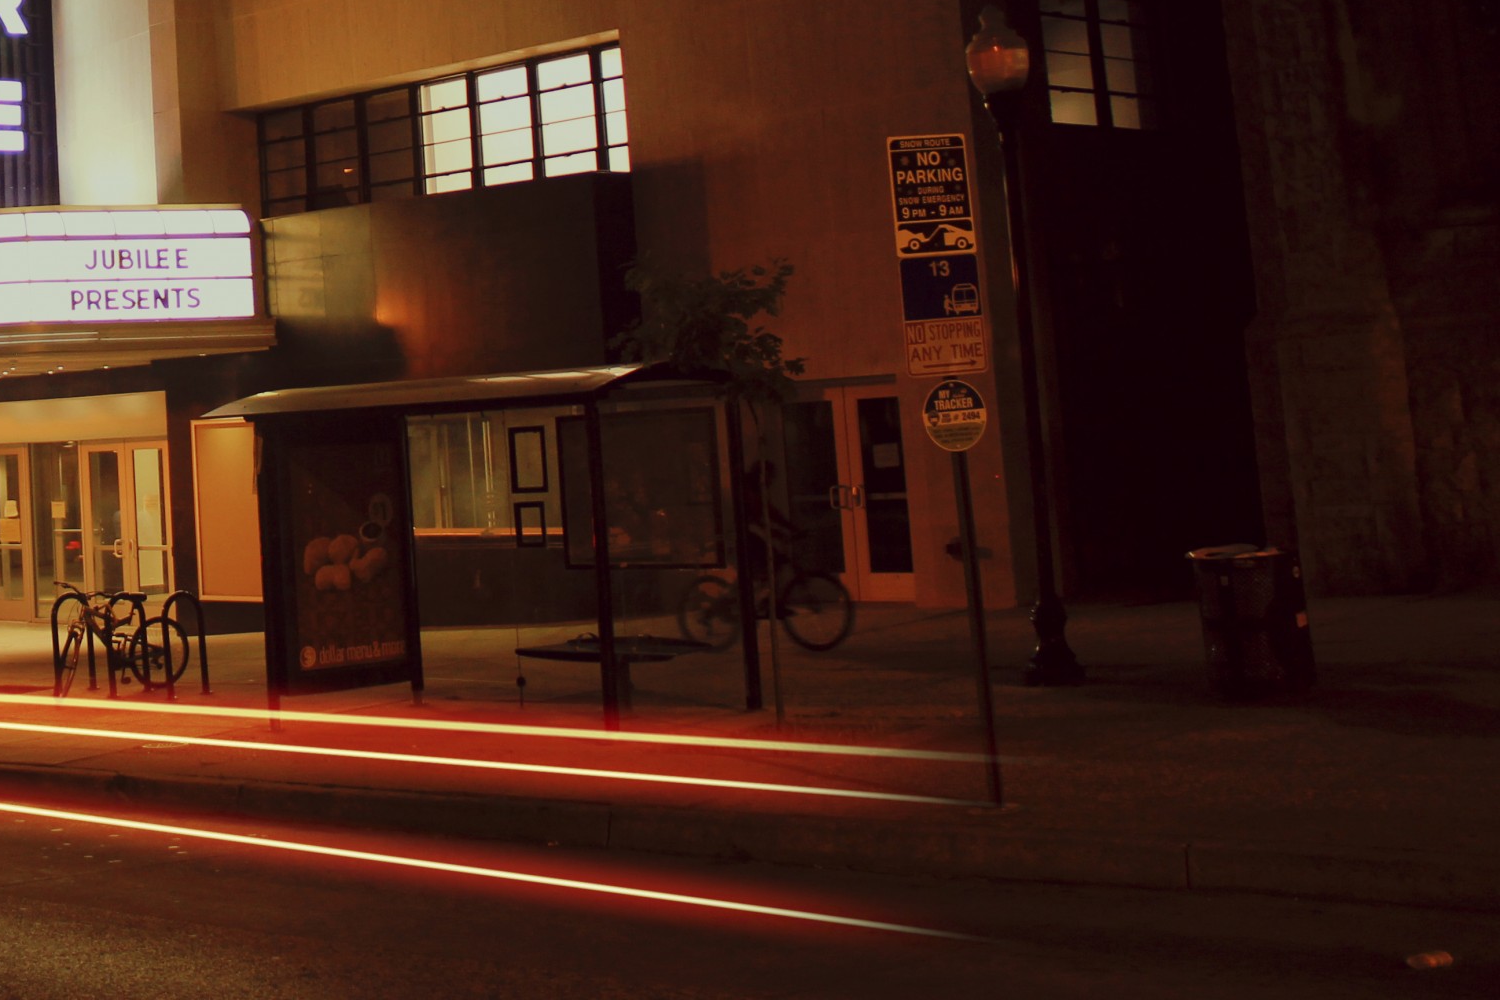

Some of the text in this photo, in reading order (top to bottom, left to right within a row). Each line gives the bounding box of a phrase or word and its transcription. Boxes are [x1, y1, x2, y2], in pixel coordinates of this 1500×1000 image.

[900, 137, 950, 149] SNOW ROUTE
[916, 150, 940, 167] NO
[896, 167, 964, 185] PARKING
[898, 193, 965, 205] SNOW EMERGENCY
[917, 186, 944, 195] DURING
[902, 206, 910, 219] 9
[912, 209, 927, 218] PM
[938, 204, 947, 217] 9
[949, 206, 964, 215] AM
[85, 248, 189, 270] JUBILEE
[928, 260, 950, 277] 13
[70, 288, 200, 311] PRESENTS
[907, 321, 980, 344] NO STOPPING
[911, 342, 983, 362] ANY TIME
[934, 397, 974, 411] TRACKER
[319, 644, 345, 665] dollar
